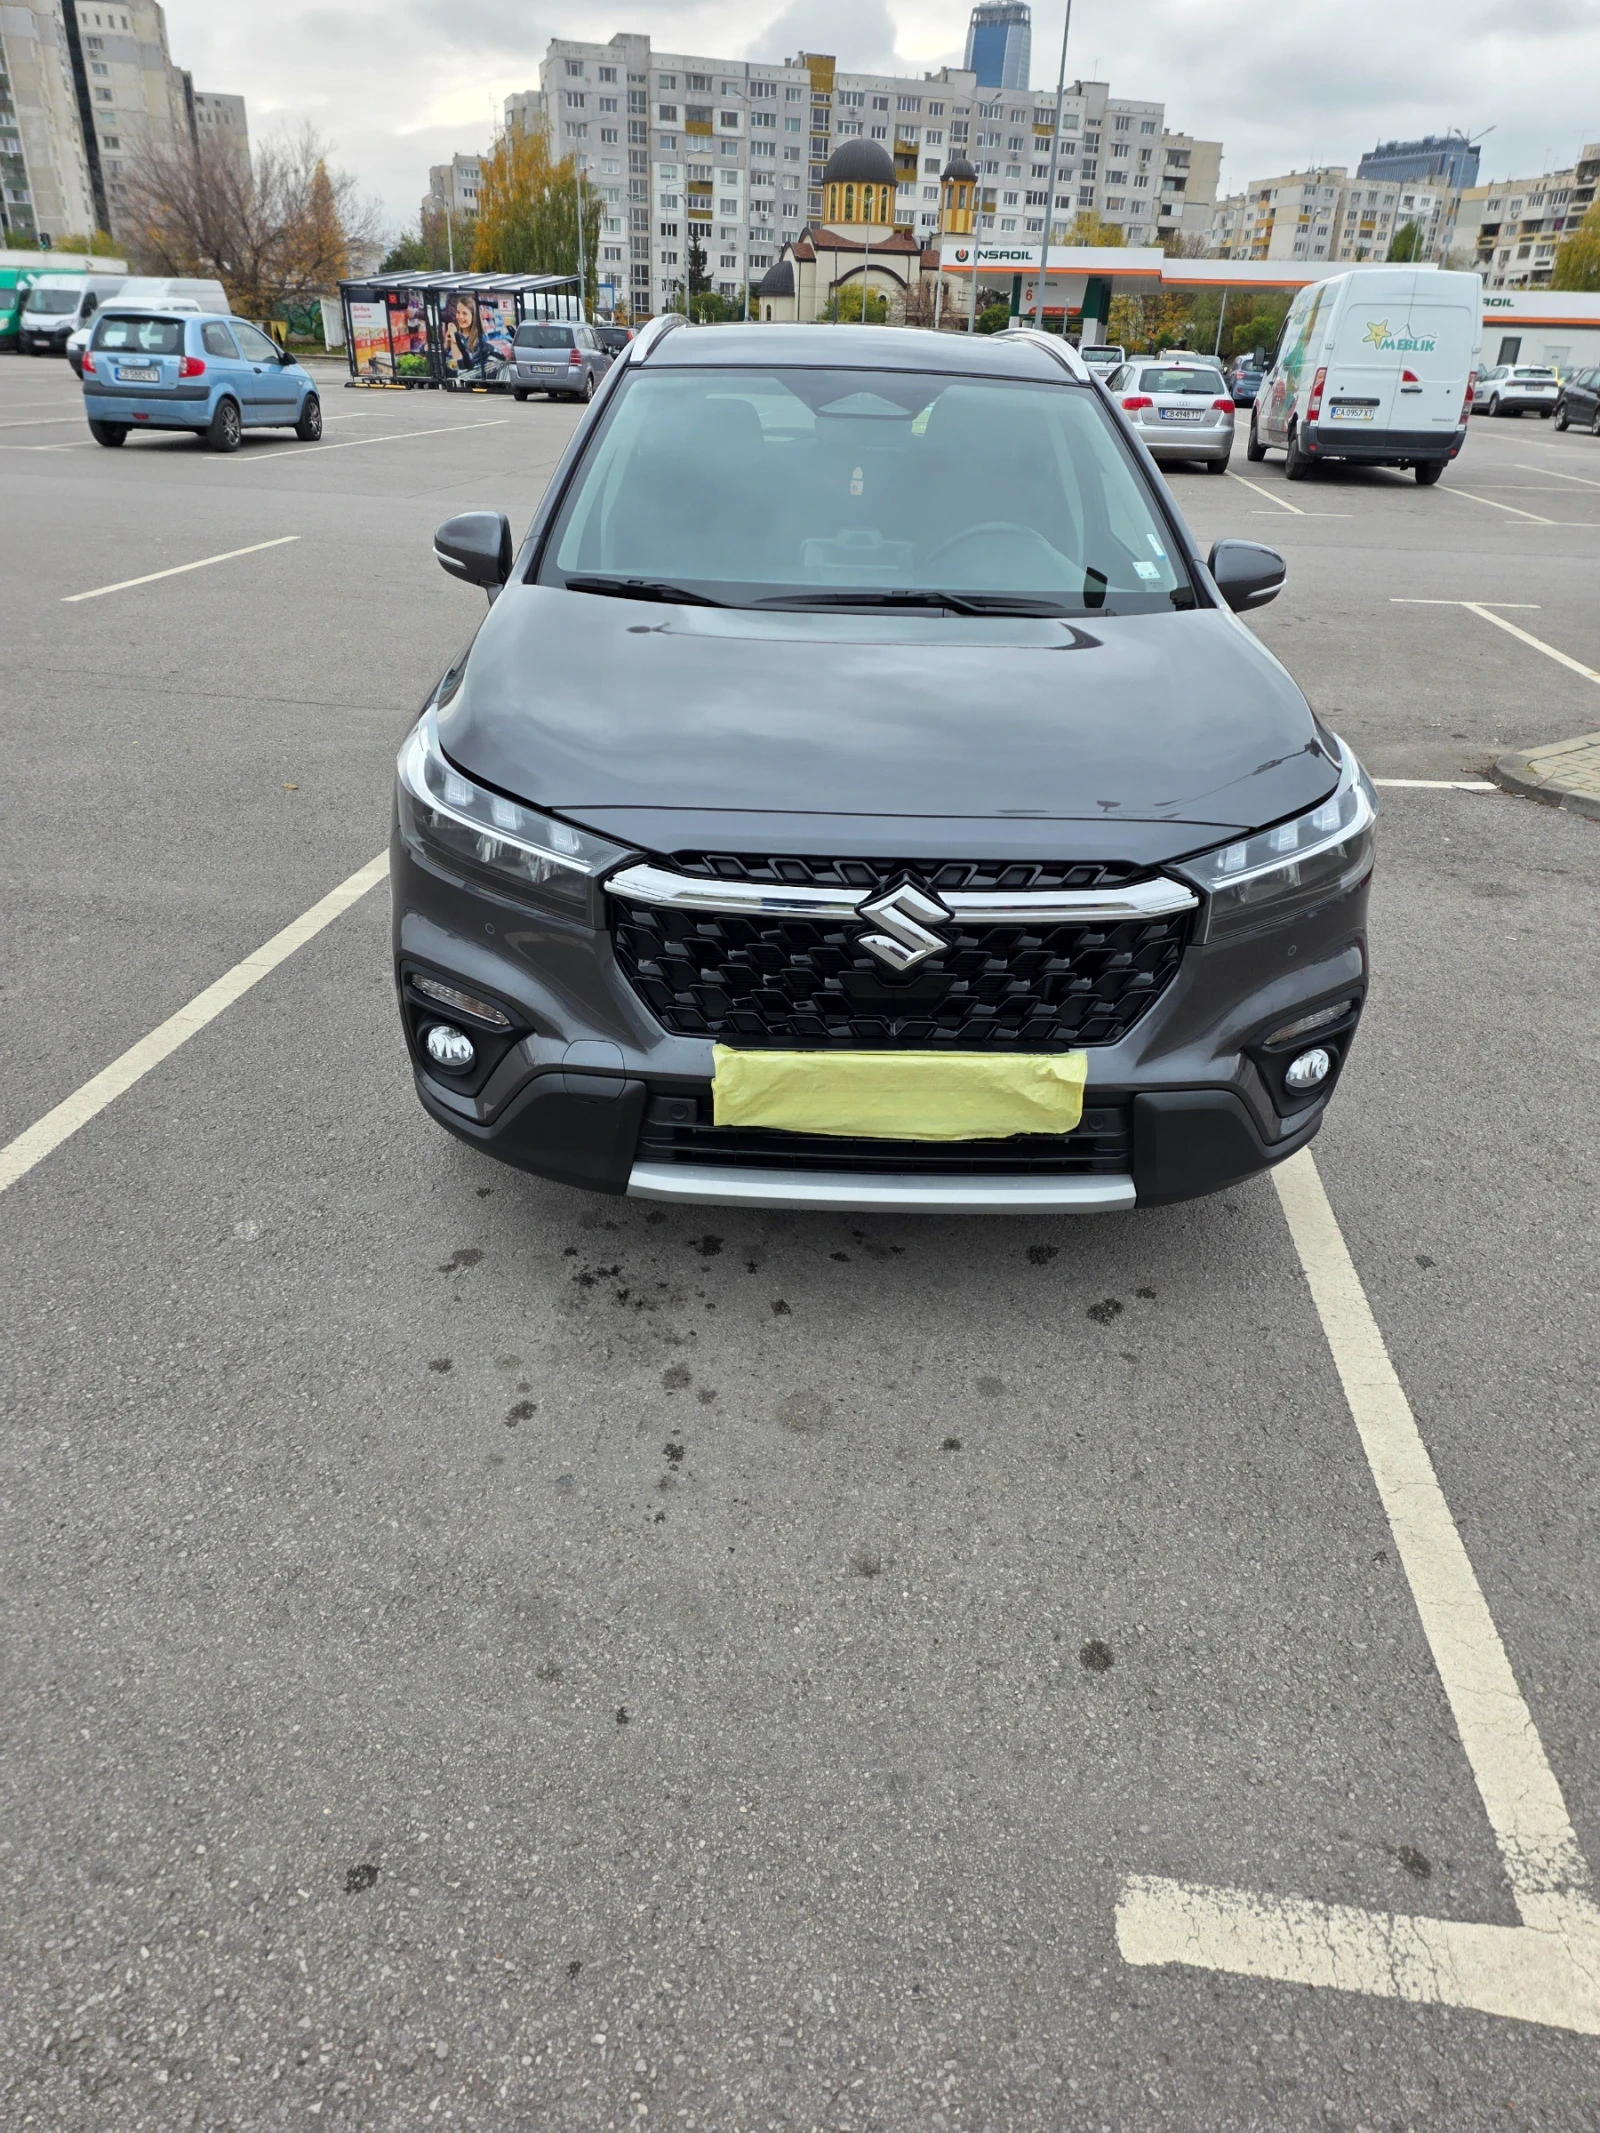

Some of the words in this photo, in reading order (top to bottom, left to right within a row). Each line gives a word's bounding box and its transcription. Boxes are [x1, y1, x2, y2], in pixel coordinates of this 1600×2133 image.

[1026, 290, 1032, 301] 6
[1483, 298, 1514, 307] AOIL
[1380, 339, 1436, 352] MEBLIK
[1346, 408, 1363, 417] 0957
